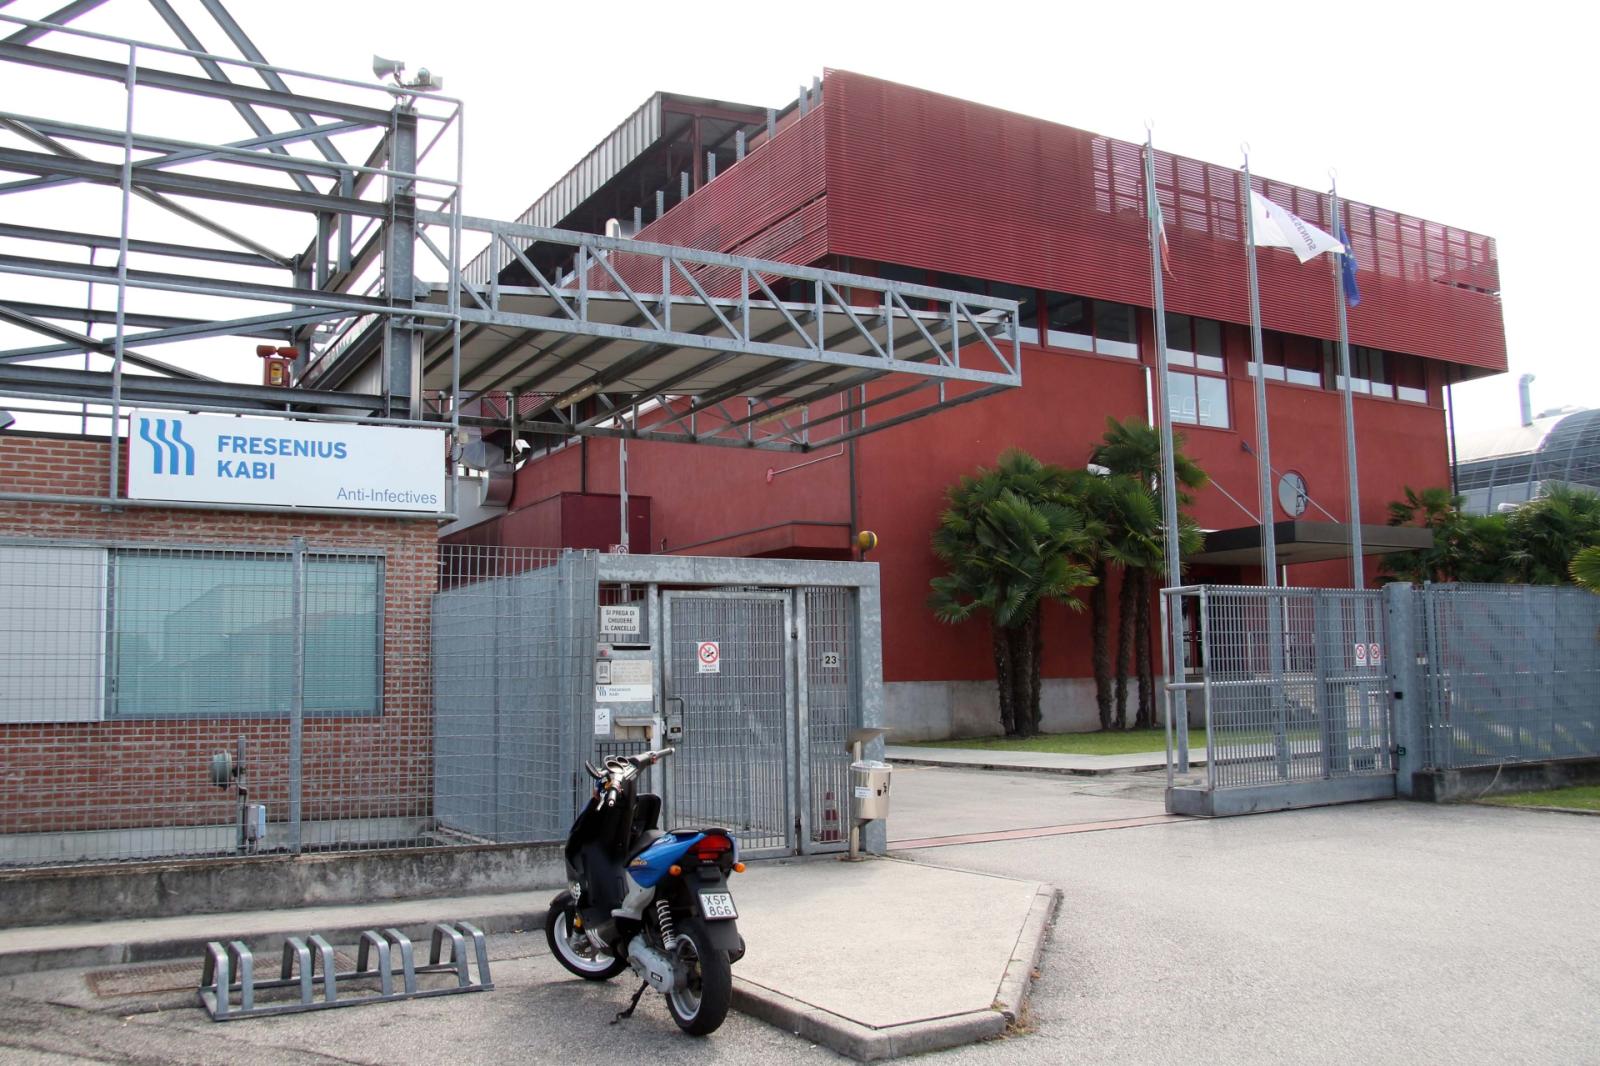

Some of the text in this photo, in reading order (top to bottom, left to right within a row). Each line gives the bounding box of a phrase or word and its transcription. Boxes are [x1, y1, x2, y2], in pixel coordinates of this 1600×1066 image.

[218, 435, 347, 459] FRESENIUS
[217, 460, 275, 480] KABI
[336, 487, 437, 504] Anti-Infectives
[825, 655, 837, 665] 23
